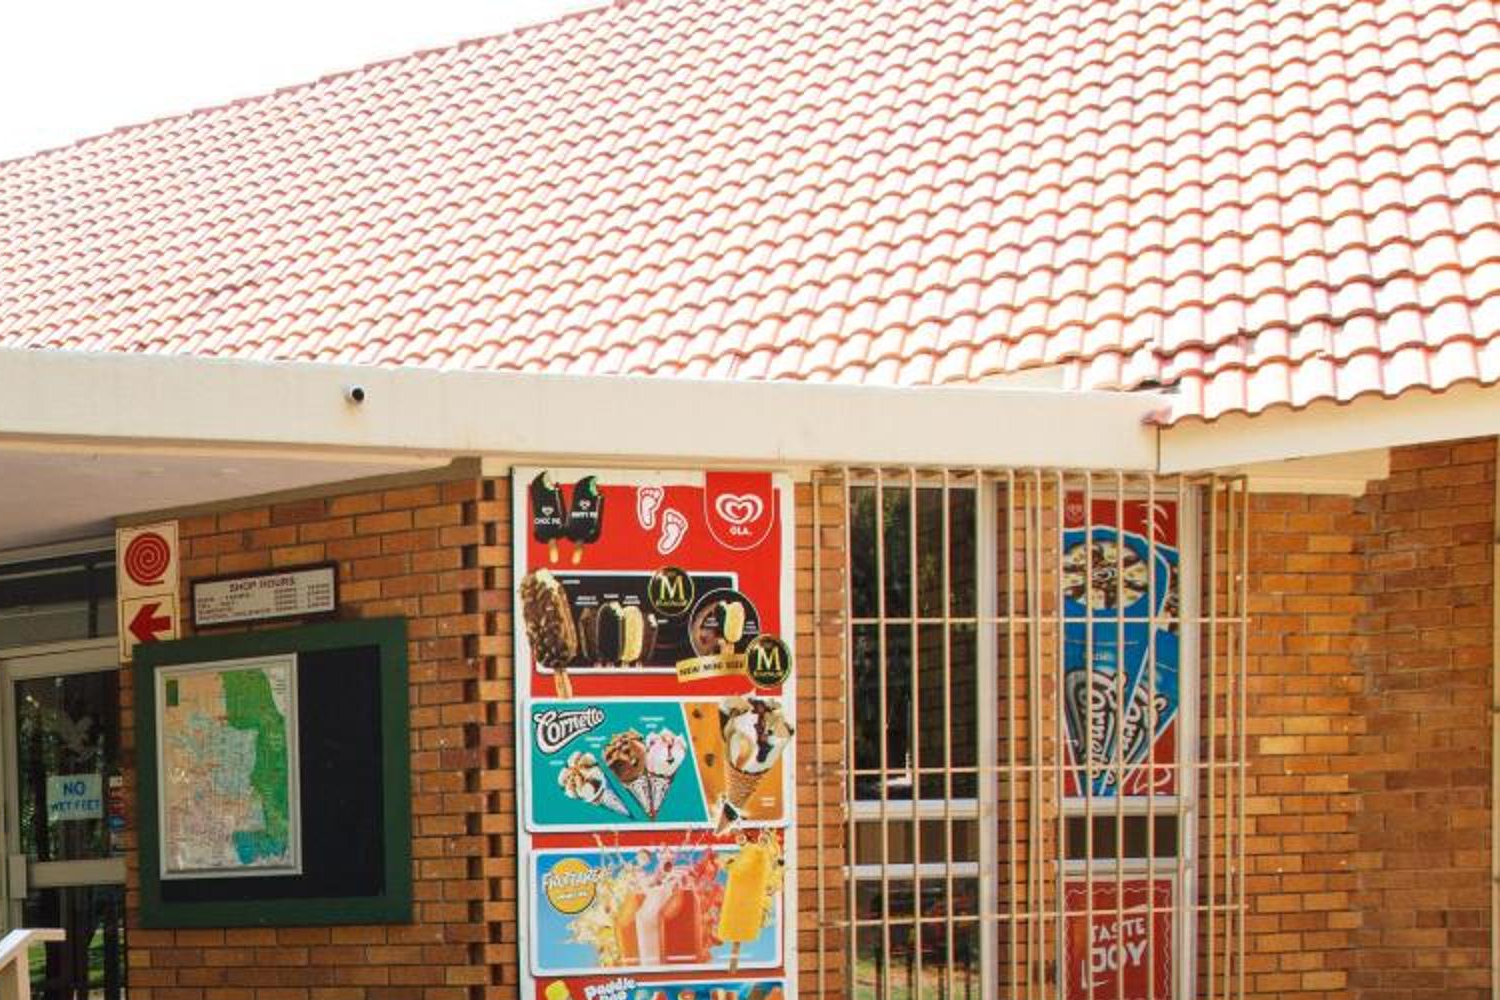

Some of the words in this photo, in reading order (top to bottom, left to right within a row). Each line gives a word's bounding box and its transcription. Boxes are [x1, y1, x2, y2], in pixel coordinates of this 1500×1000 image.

[229, 581, 257, 593] SHOP
[259, 576, 296, 589] HOURS
[534, 707, 604, 754] Cornetto
[64, 781, 86, 796] NO
[51, 801, 72, 812] WET
[76, 800, 100, 811] FEET
[1088, 917, 1145, 943] TASTE
[1088, 939, 1147, 973] JOY
